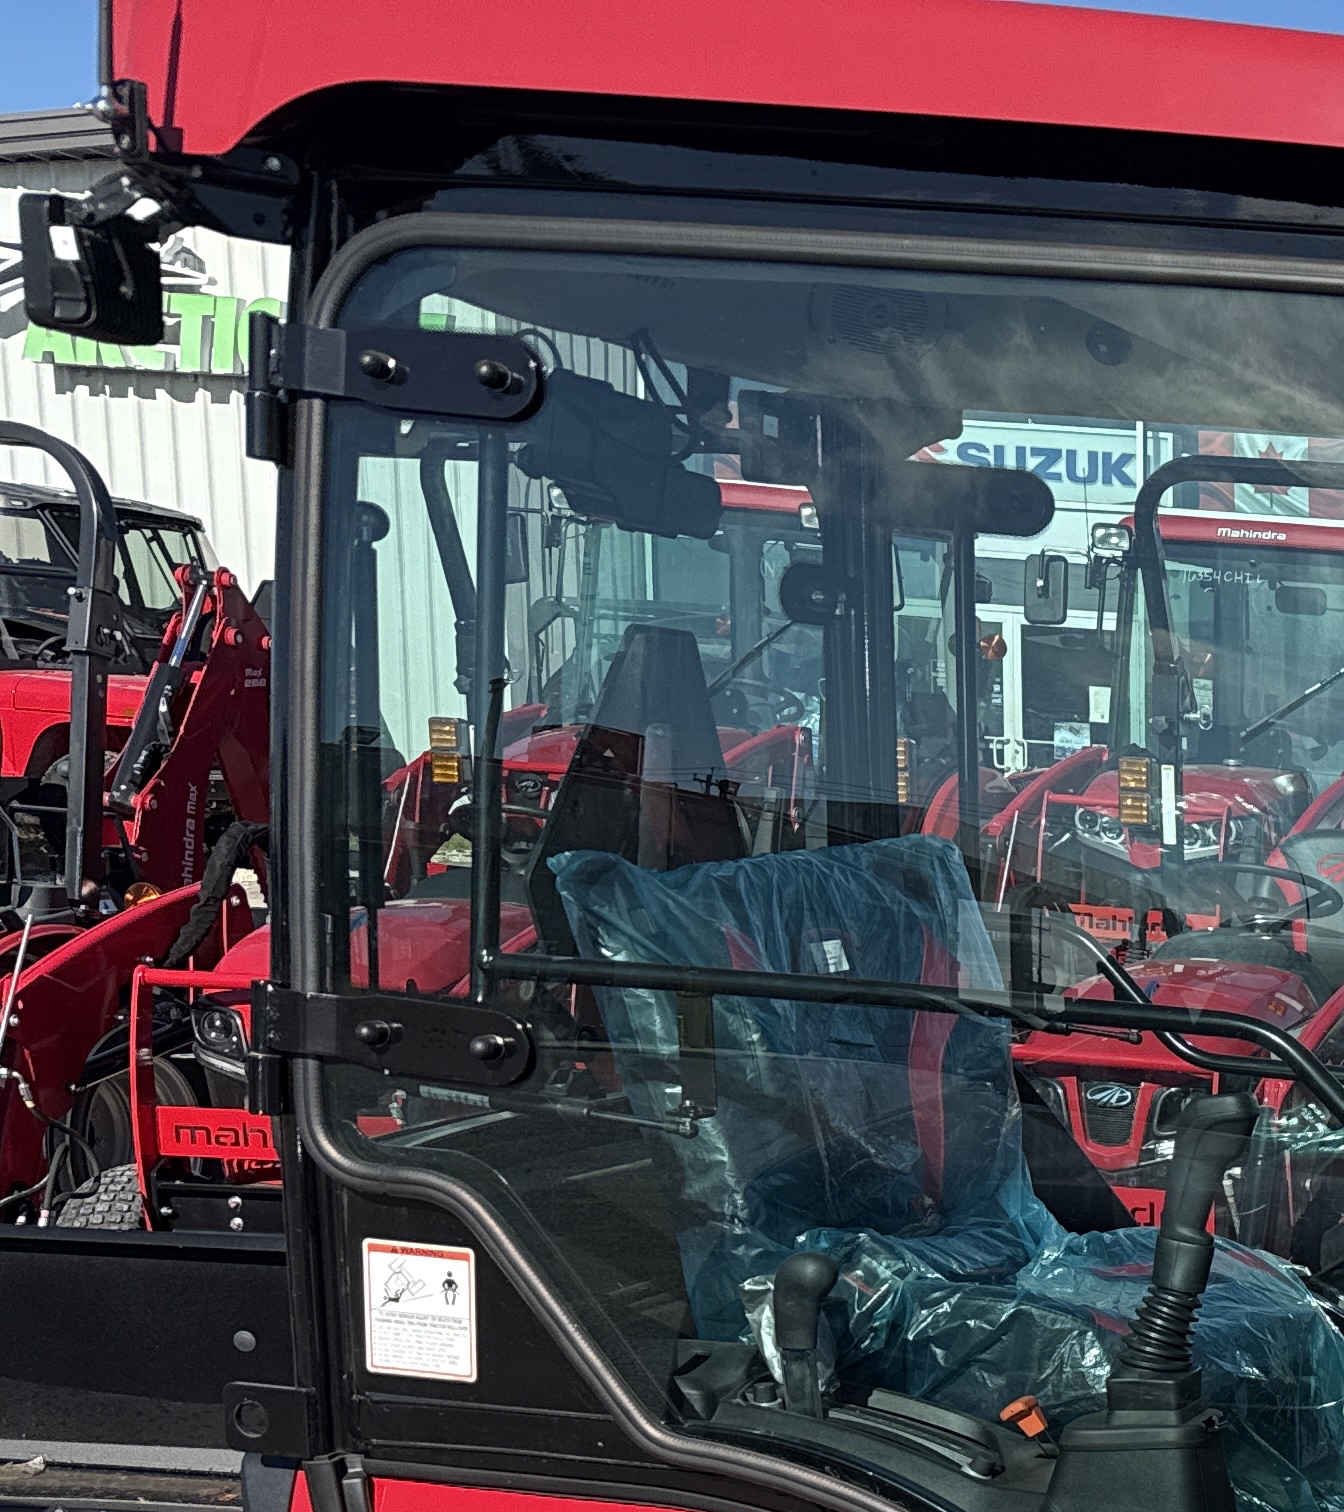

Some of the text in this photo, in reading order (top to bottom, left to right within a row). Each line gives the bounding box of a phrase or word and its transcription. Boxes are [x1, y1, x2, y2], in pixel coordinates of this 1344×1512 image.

[956, 442, 1136, 487] SUZUK
[1217, 527, 1288, 541] Mahindra
[181, 819, 197, 887] ahindra
